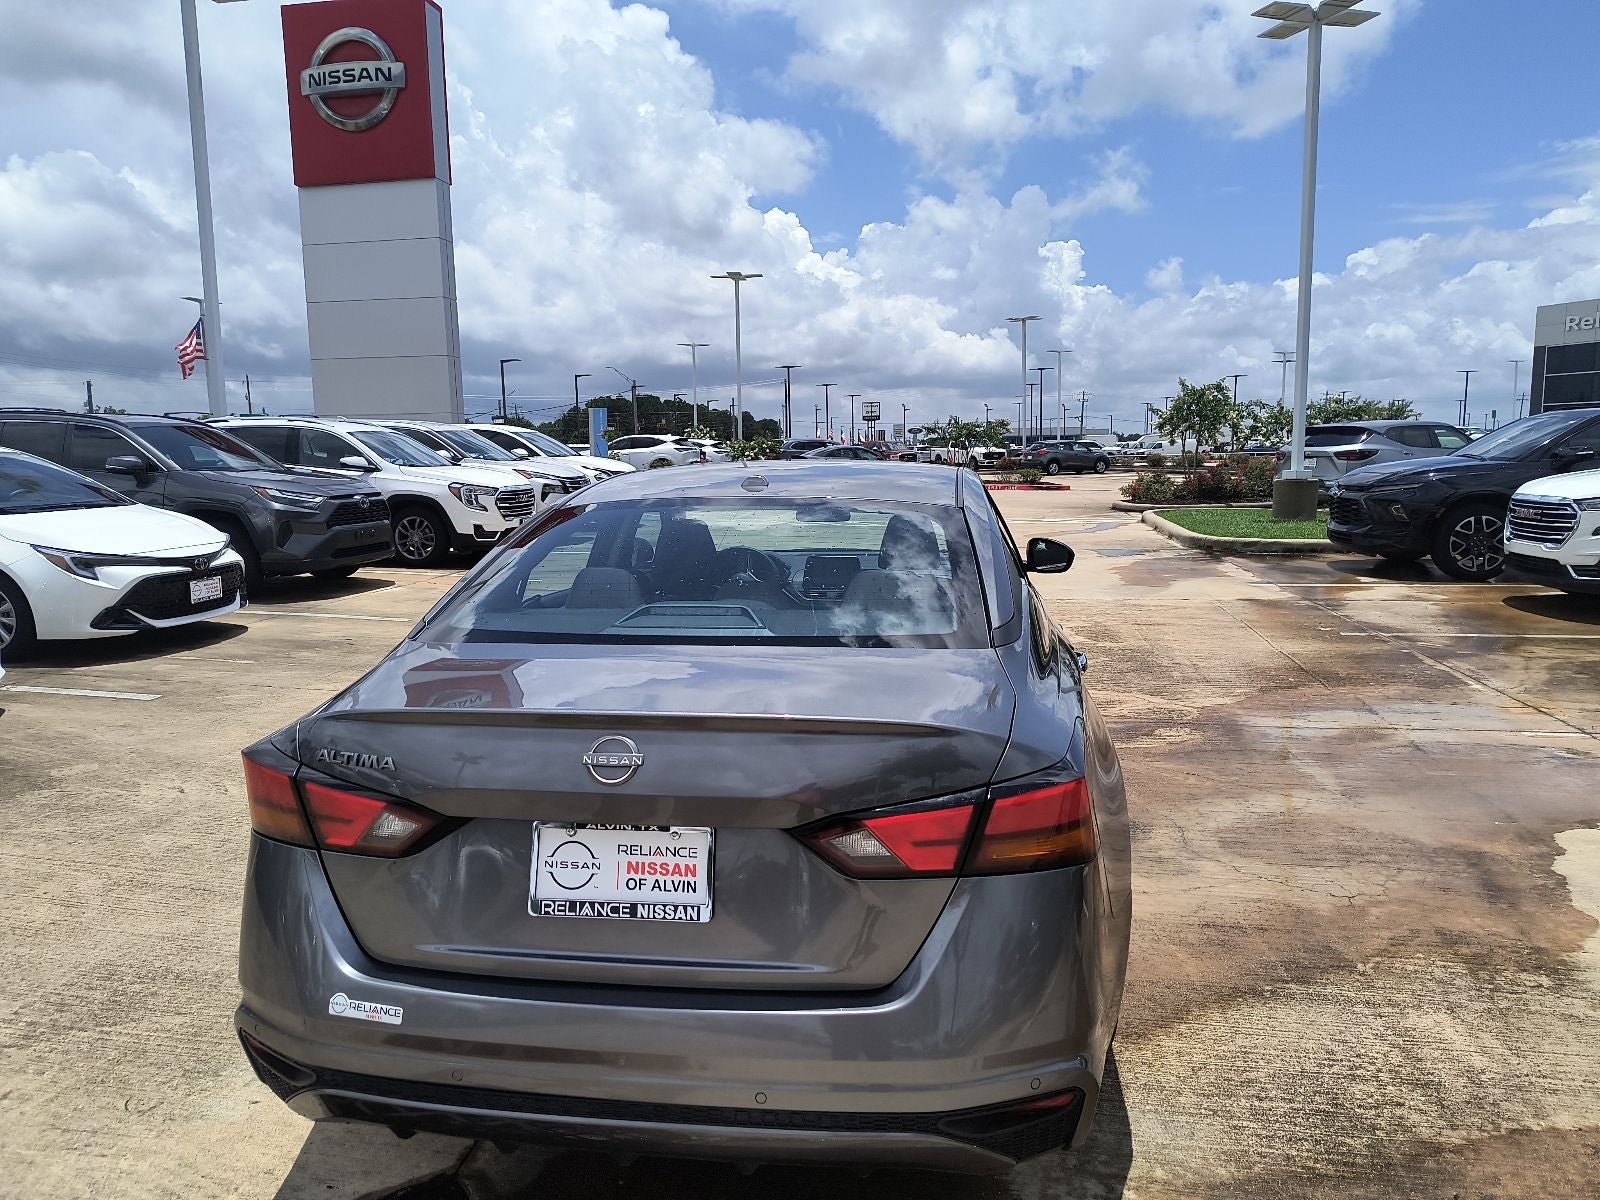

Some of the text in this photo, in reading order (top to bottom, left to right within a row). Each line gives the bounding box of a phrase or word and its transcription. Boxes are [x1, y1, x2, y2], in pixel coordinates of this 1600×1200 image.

[308, 67, 393, 89] NISSAN
[317, 748, 397, 772] ALTIMA
[582, 755, 644, 766] NISSAN
[617, 844, 698, 858] RELIANCE
[544, 860, 601, 871] NISSAN
[626, 860, 697, 878] NISSAN
[626, 877, 697, 894] OF ALVIN
[541, 901, 698, 921] RELIANCE NISSAN
[349, 1001, 402, 1018] RELIANCE
